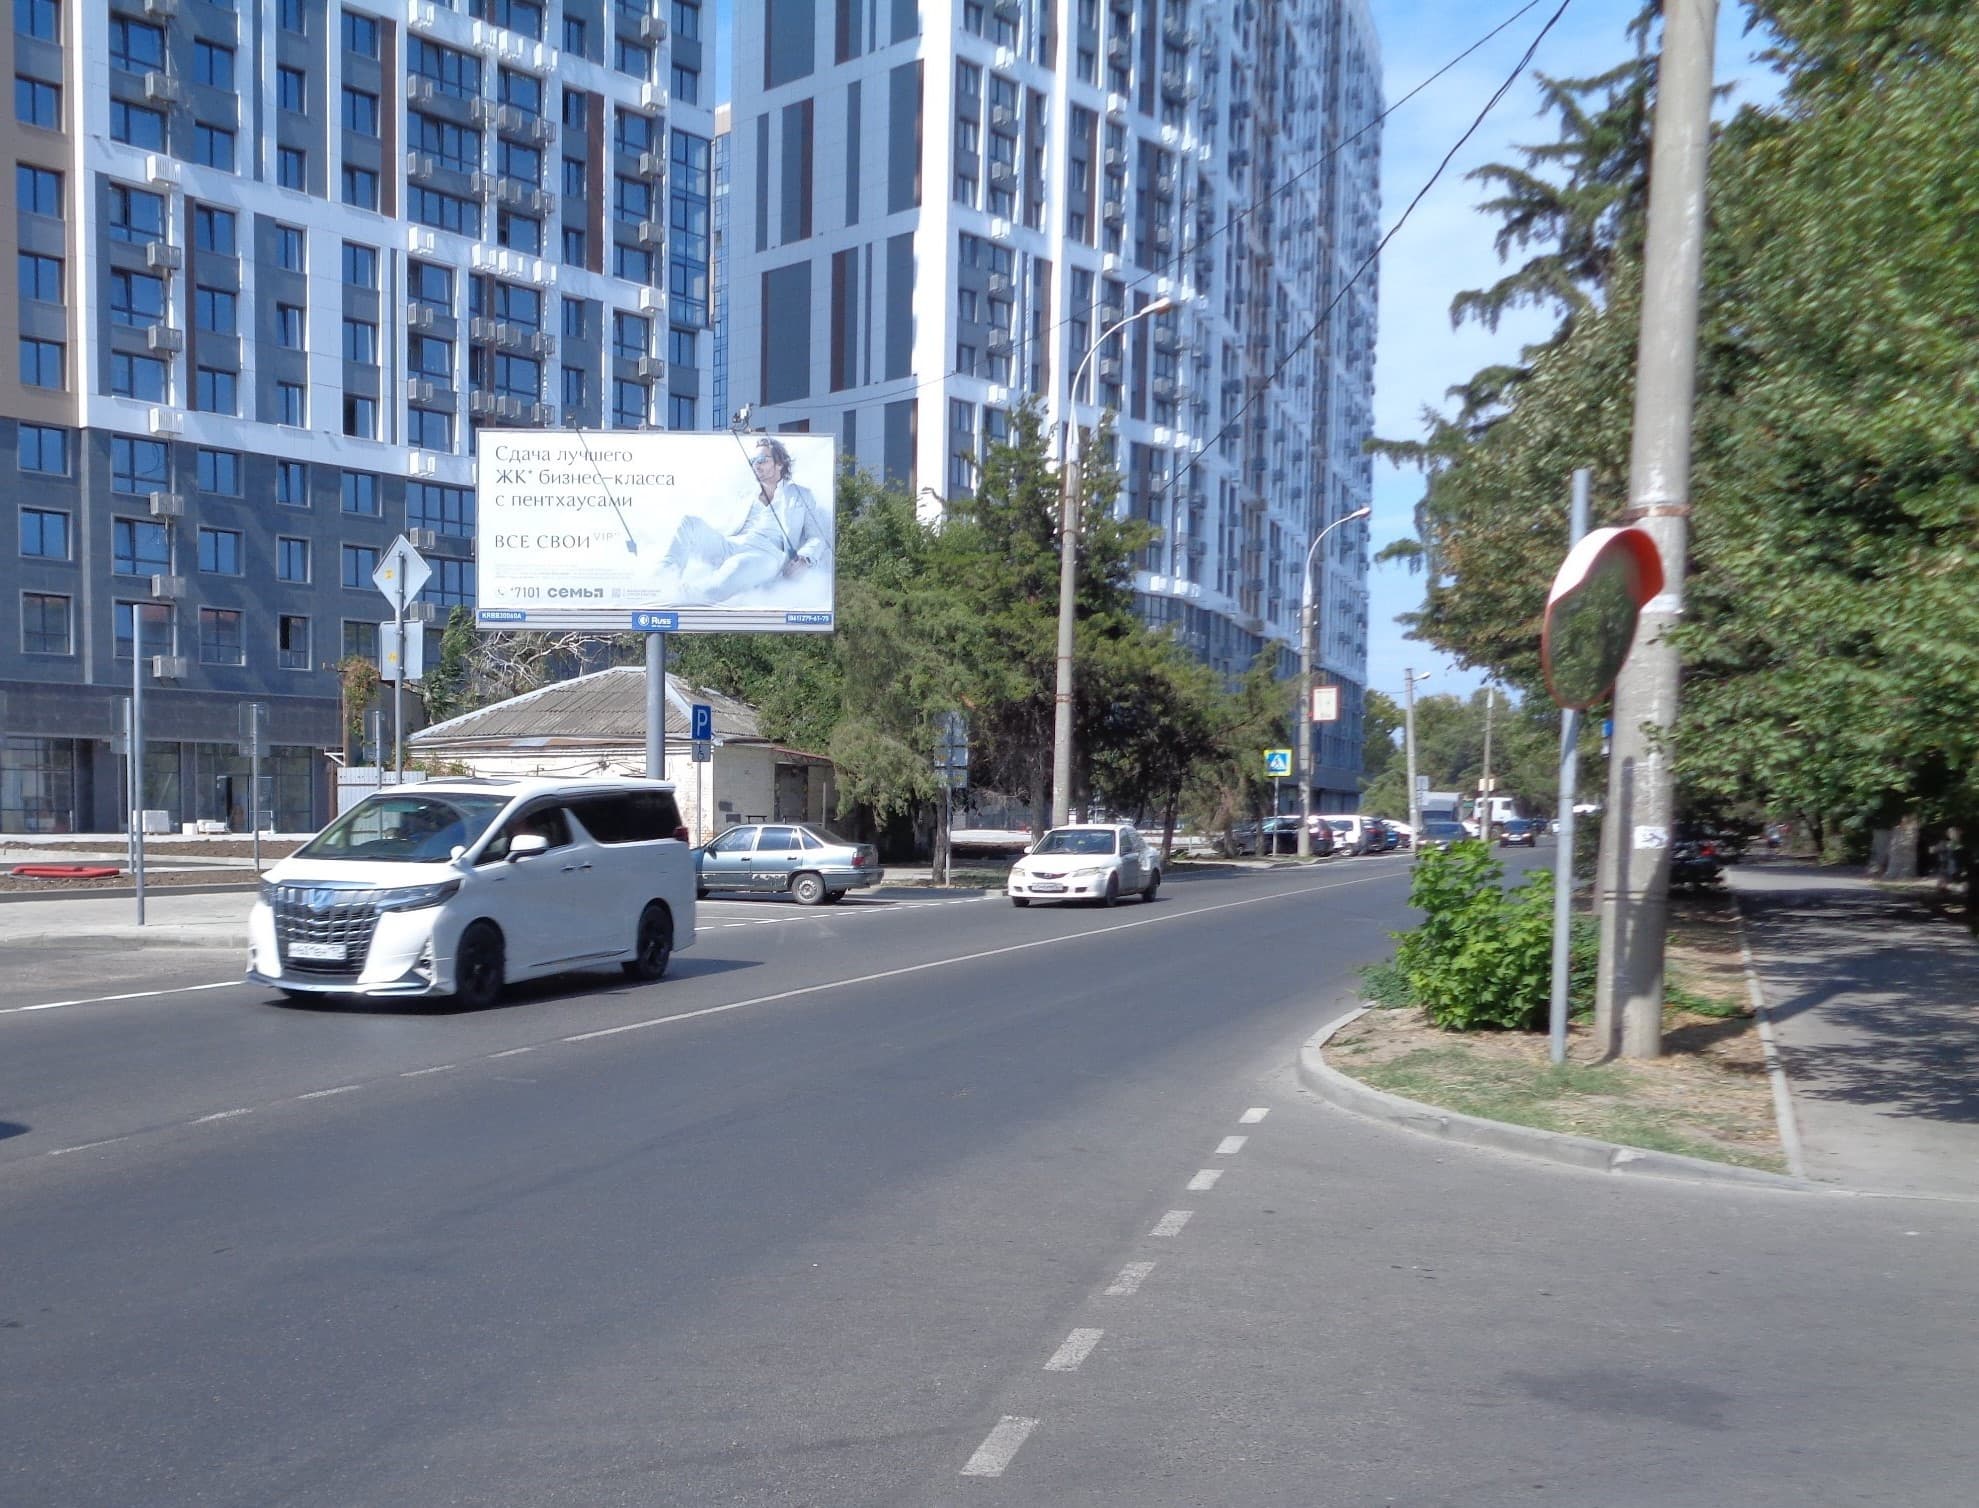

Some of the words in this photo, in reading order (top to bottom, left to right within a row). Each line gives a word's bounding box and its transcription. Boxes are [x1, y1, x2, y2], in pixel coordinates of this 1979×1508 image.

[495, 445, 551, 463] Сдача
[556, 449, 633, 465] лучшего
[495, 494, 505, 507] с
[511, 494, 633, 511] пентхаусами
[495, 535, 530, 549] ВСЕ
[536, 534, 590, 549] СВОИ
[697, 709, 708, 736] P
